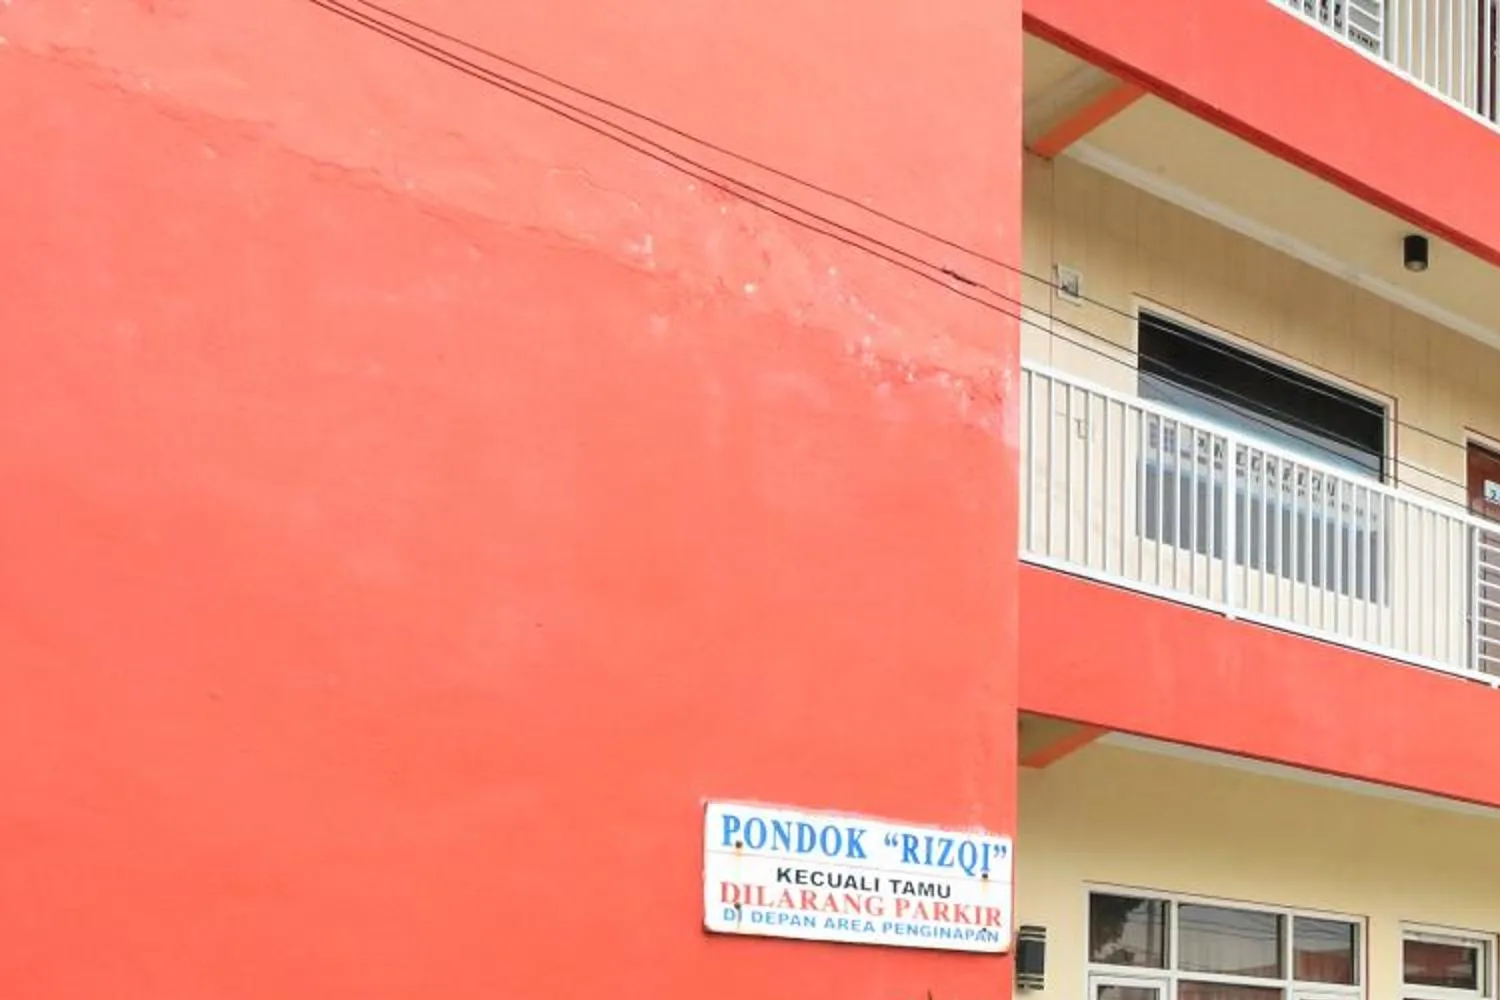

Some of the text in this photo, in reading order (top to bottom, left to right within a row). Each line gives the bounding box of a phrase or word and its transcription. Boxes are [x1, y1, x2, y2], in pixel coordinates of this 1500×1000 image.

[721, 814, 867, 859] PONDOK
[777, 866, 951, 899] KECUALI TAMU
[720, 881, 1002, 927] DILARANG PARKIR
[751, 910, 816, 928] DEPAN
[824, 917, 875, 933] AREA
[882, 921, 999, 943] PENGINAPAN
